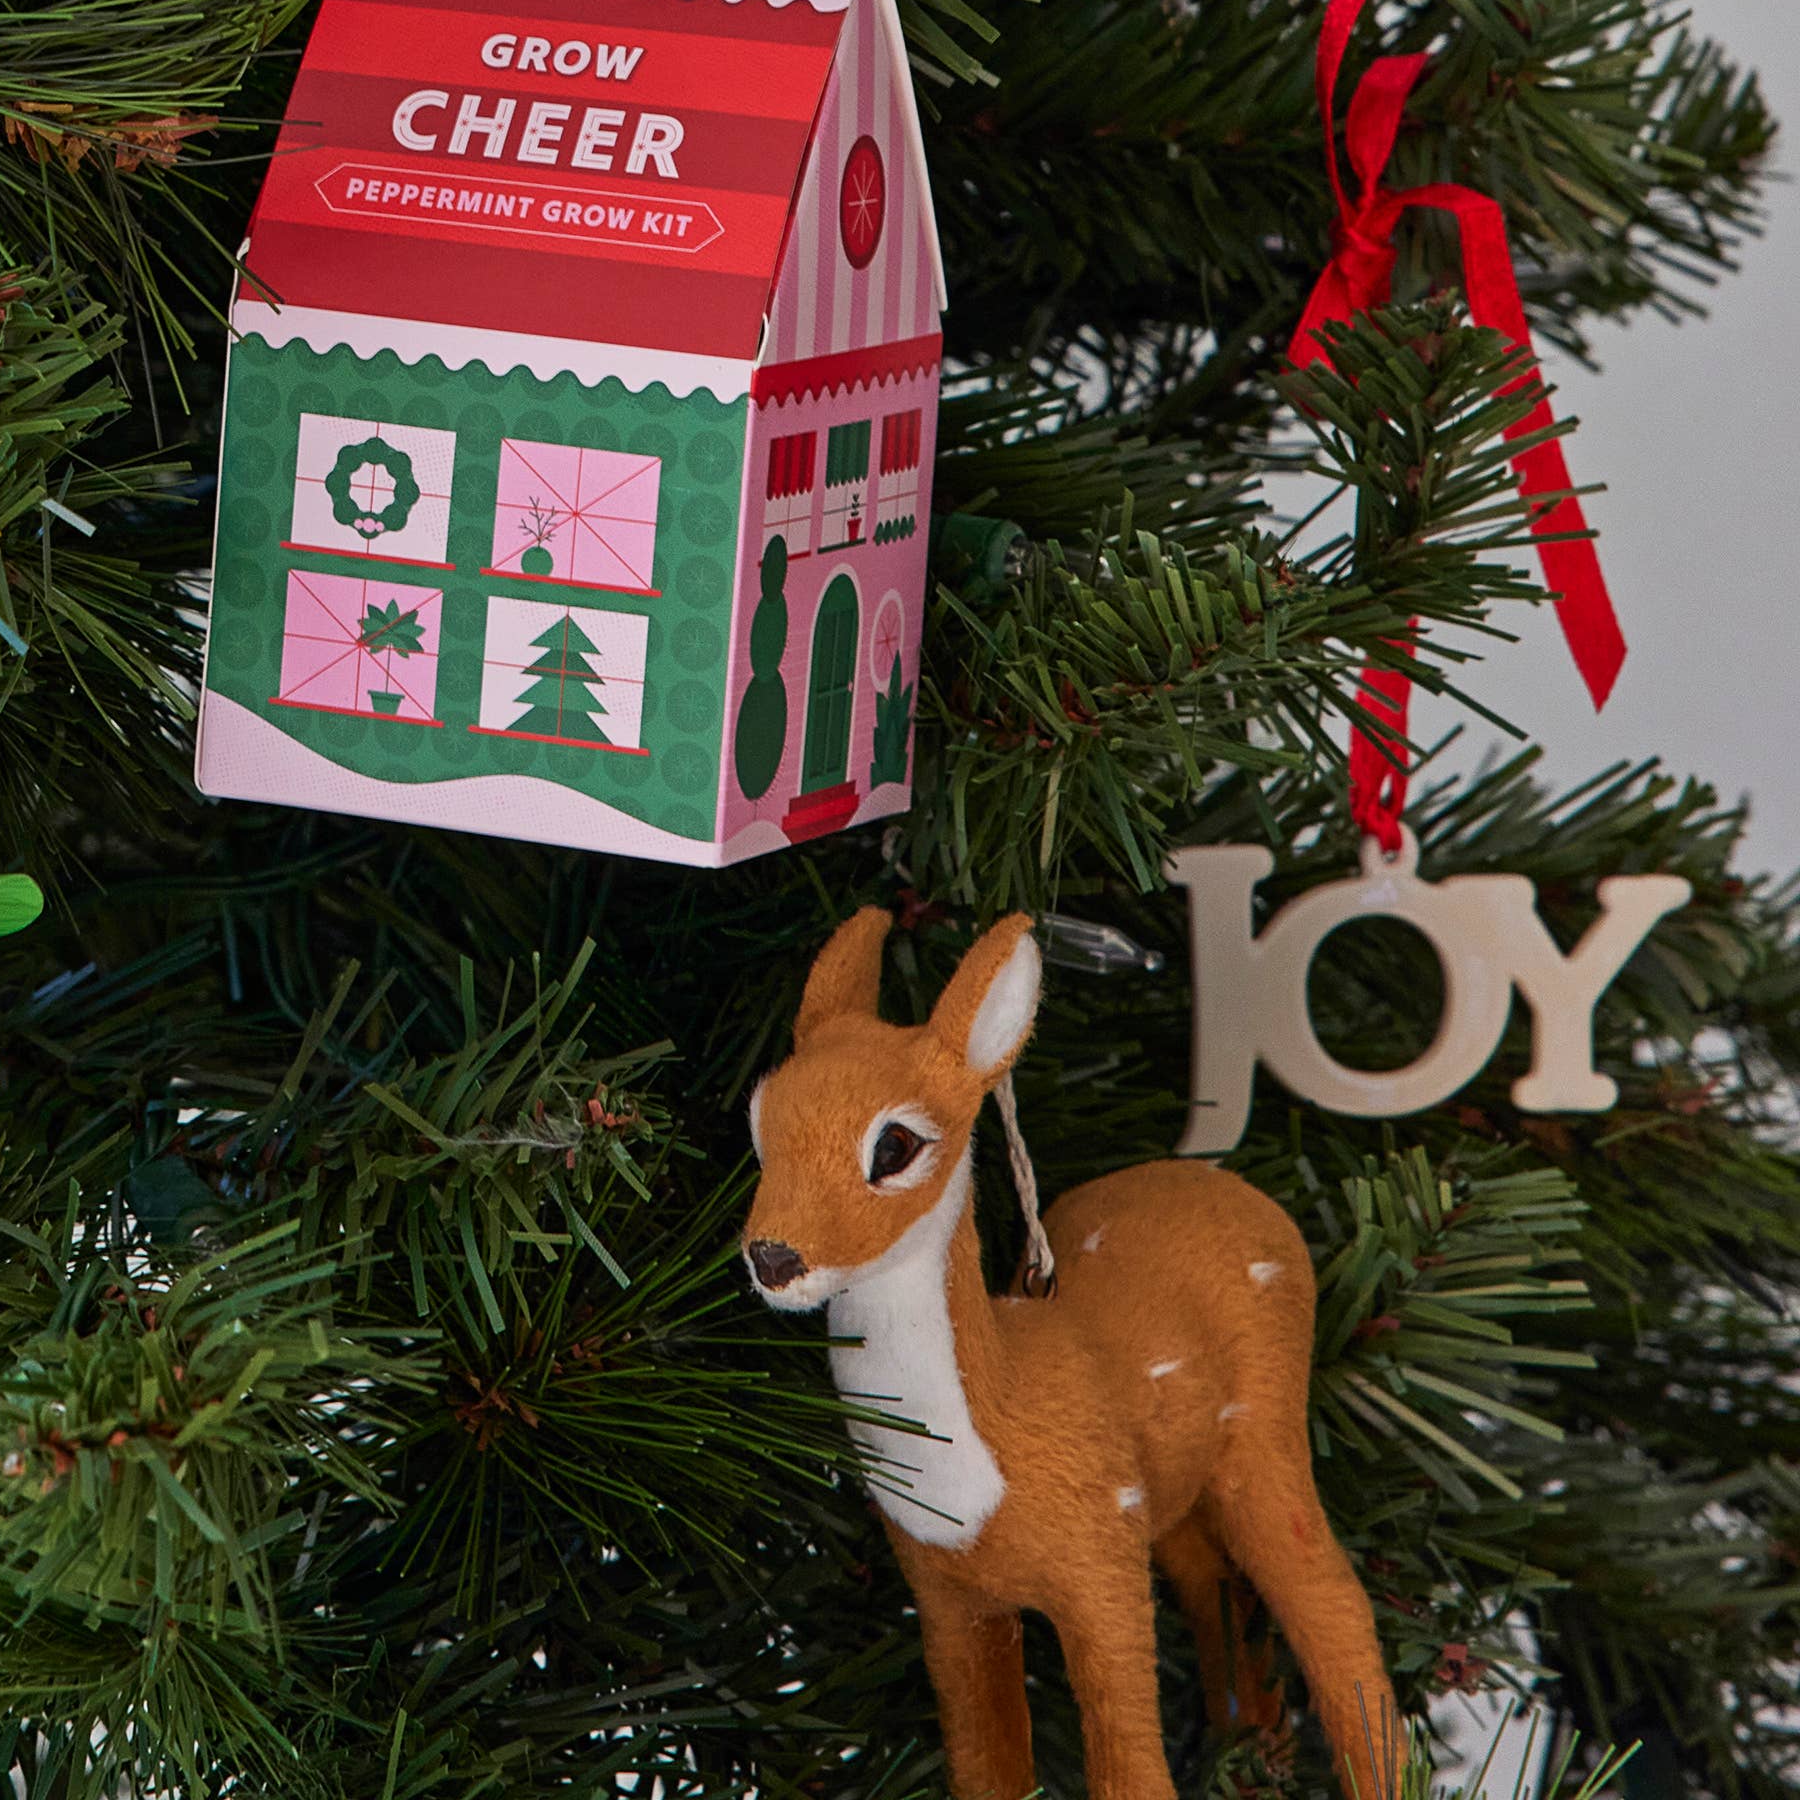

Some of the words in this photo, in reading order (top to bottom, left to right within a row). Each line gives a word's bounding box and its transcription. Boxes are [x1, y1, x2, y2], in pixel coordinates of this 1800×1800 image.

[481, 33, 645, 82] GROW
[392, 89, 685, 180] CHEER
[346, 177, 534, 219] PEPPERMINT
[542, 200, 635, 231] GROW
[642, 212, 693, 238] KIT
[1162, 843, 1693, 1156] JOY
